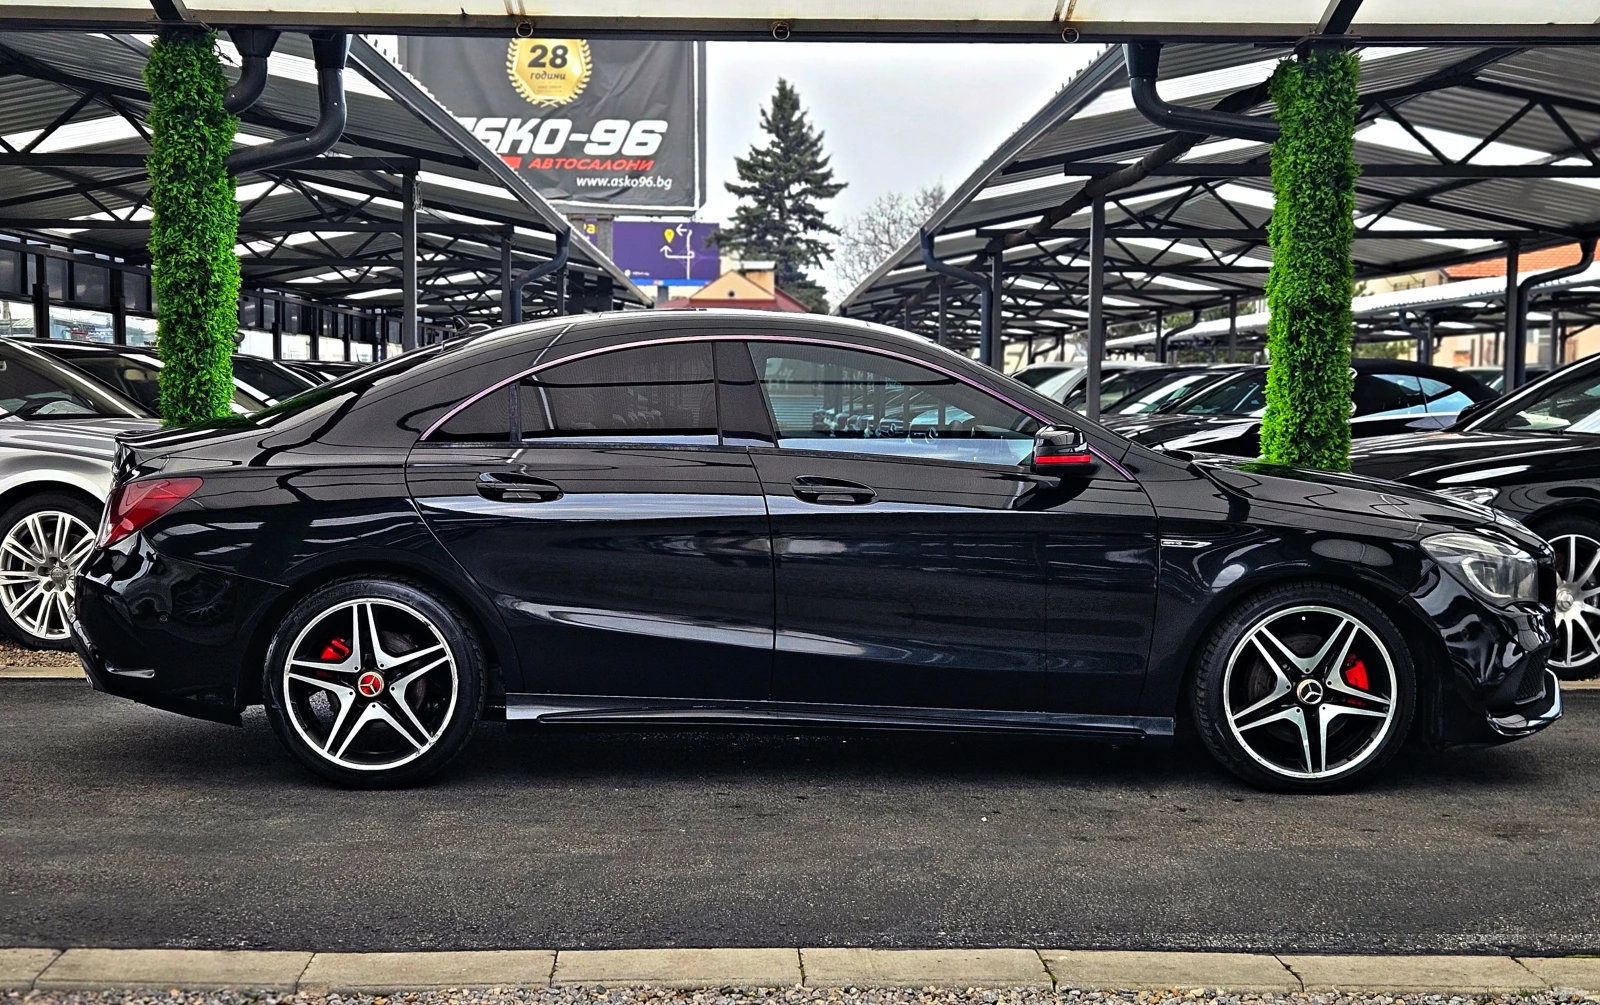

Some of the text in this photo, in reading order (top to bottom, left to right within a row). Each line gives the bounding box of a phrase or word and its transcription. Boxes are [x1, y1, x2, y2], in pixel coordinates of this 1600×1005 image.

[528, 44, 568, 69] 28
[530, 70, 566, 80] години
[528, 156, 655, 171] АВТОСАЛОНИ
[576, 175, 673, 190] www.asko96.bg
